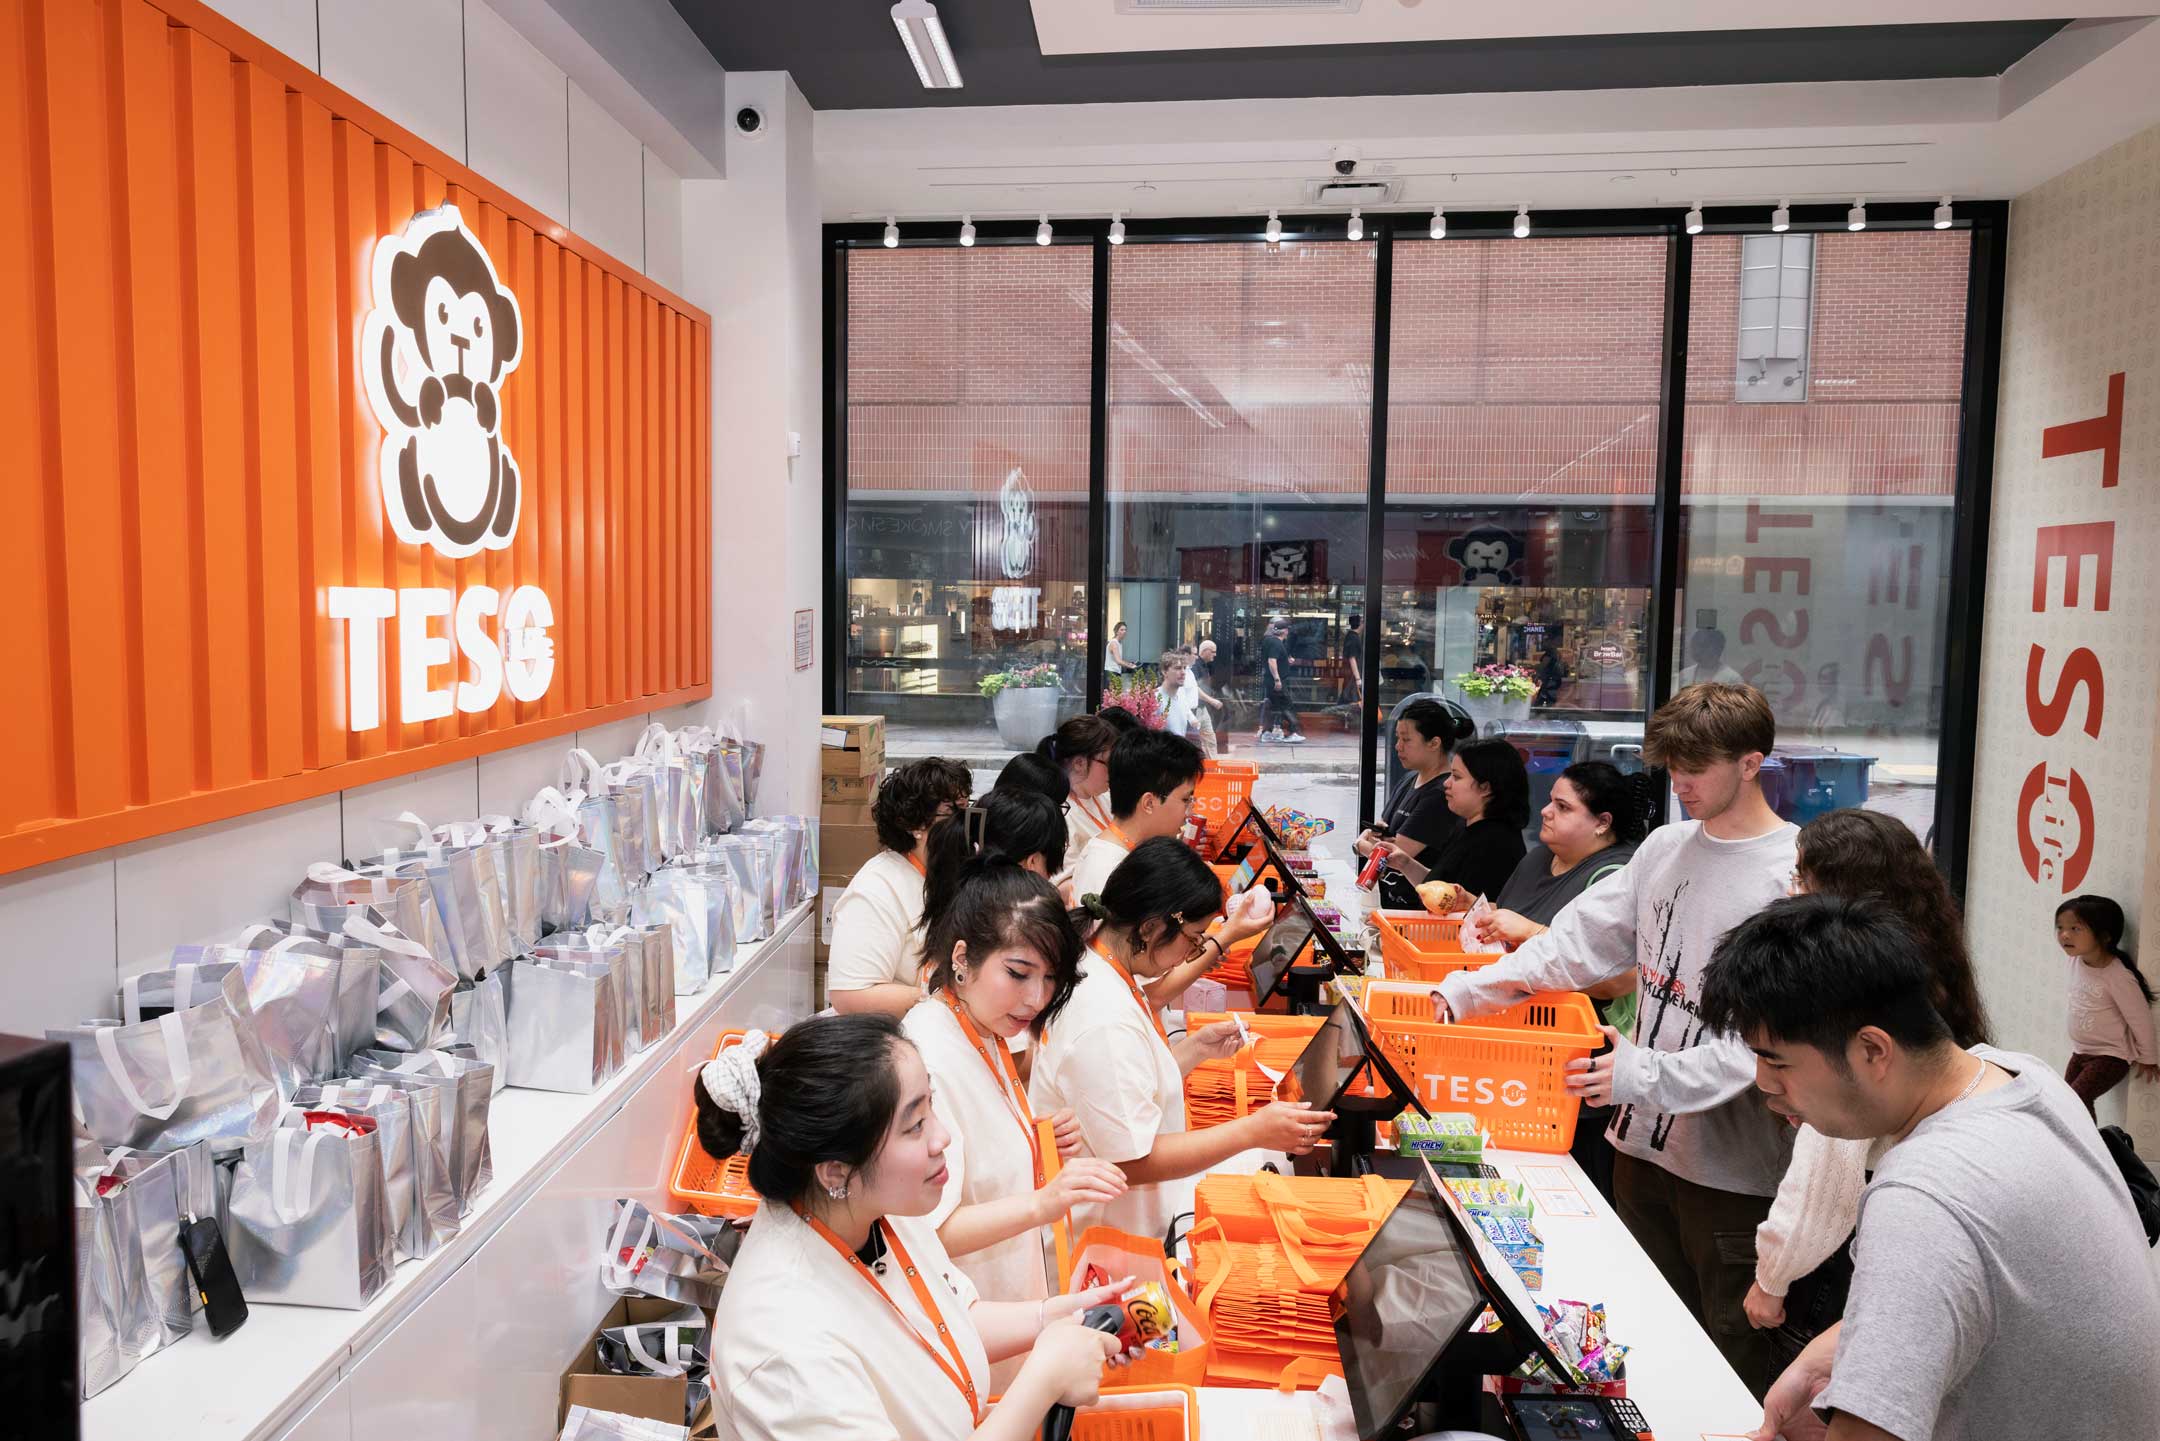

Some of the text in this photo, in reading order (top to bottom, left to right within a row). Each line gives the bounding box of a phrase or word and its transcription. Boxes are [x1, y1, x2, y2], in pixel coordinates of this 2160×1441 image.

[328, 585, 555, 732] TESO
[2017, 371, 2125, 894] TESO
[2039, 770, 2068, 881] Life
[1411, 1139, 1445, 1151] HI-CHEW
[1424, 1073, 1528, 1108] TESO
